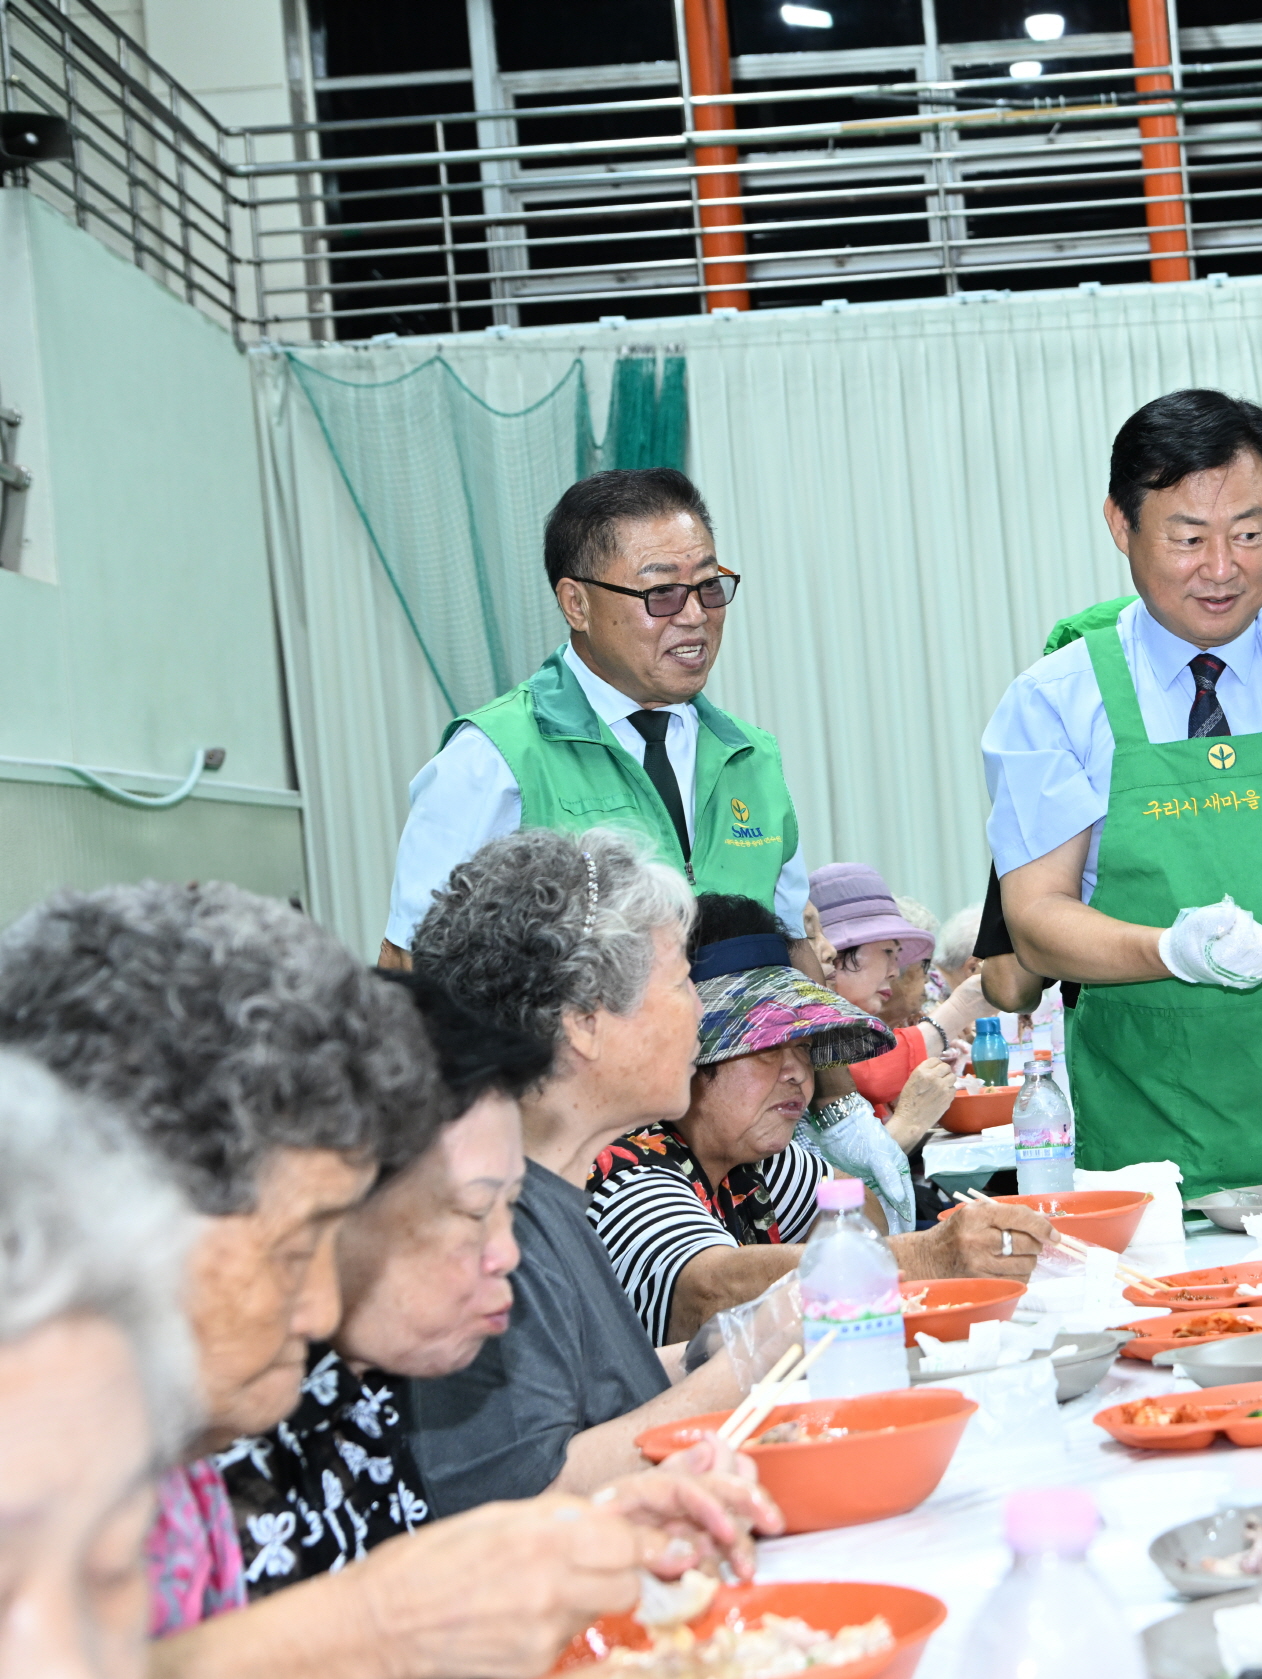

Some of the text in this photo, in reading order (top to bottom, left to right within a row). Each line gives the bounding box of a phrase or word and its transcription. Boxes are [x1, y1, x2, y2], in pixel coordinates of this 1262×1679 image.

[1142, 797, 1198, 821] 구리시
[1203, 789, 1260, 814] 새마을
[731, 825, 764, 838] SMU
